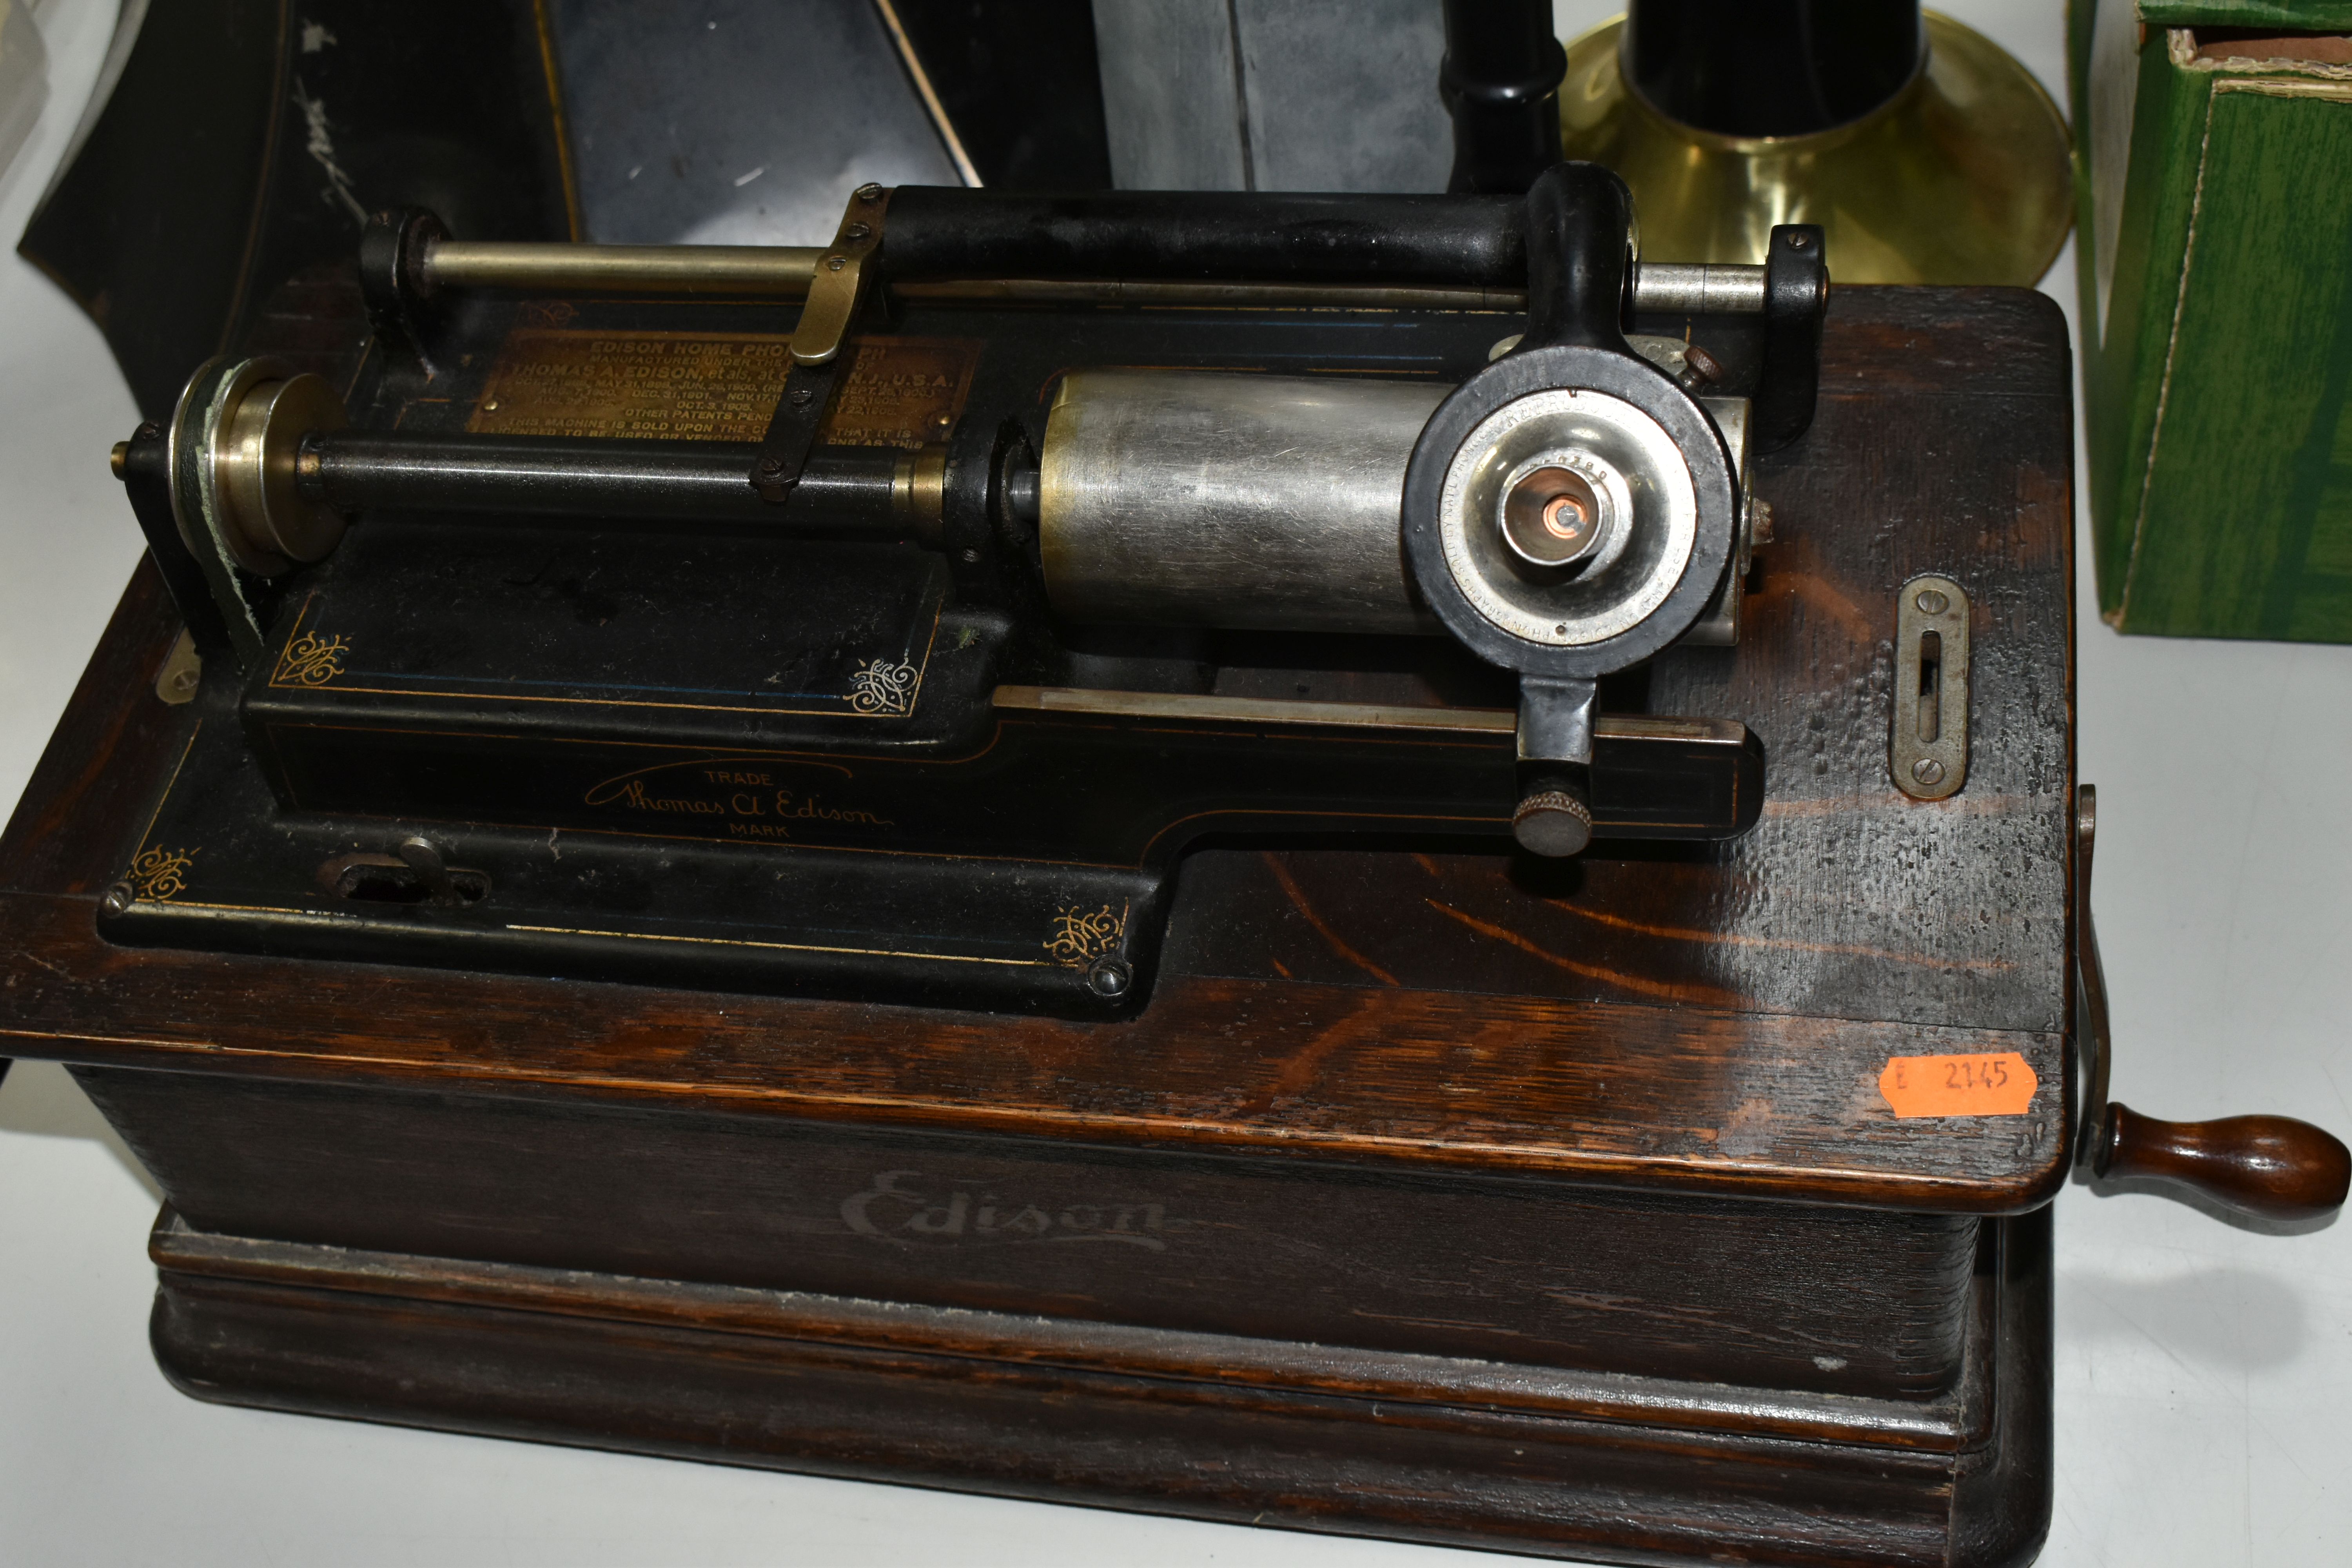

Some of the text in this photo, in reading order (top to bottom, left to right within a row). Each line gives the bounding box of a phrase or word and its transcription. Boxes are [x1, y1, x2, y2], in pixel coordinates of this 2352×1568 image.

[590, 341, 666, 354] EDISON
[674, 343, 733, 355] HOME
[590, 355, 700, 365] MANUFACTURED
[704, 358, 752, 366] UNDER
[757, 359, 783, 367] THE
[513, 362, 595, 377] THOMAS
[600, 366, 618, 377] A.
[623, 367, 704, 381] EDISON,
[708, 368, 725, 379] et
[758, 369, 773, 381] at
[625, 409, 773, 421] OTHER PATENTS PEND
[510, 417, 539, 426] THIS
[545, 418, 608, 428] MACHINE
[612, 421, 626, 429] IS
[631, 421, 669, 431] SOLD
[674, 423, 713, 432] UPON
[720, 425, 746, 433] THE
[836, 428, 871, 438] THAT
[897, 429, 912, 438] IS
[1445, 541, 1466, 577] SOLD
[1460, 577, 1550, 641] PHONOGRAPHS
[705, 771, 773, 786] TRADE
[624, 779, 724, 815] Thomas
[776, 790, 895, 826] Edison
[730, 822, 790, 838] MARK
[839, 1170, 1166, 1250] Edison
